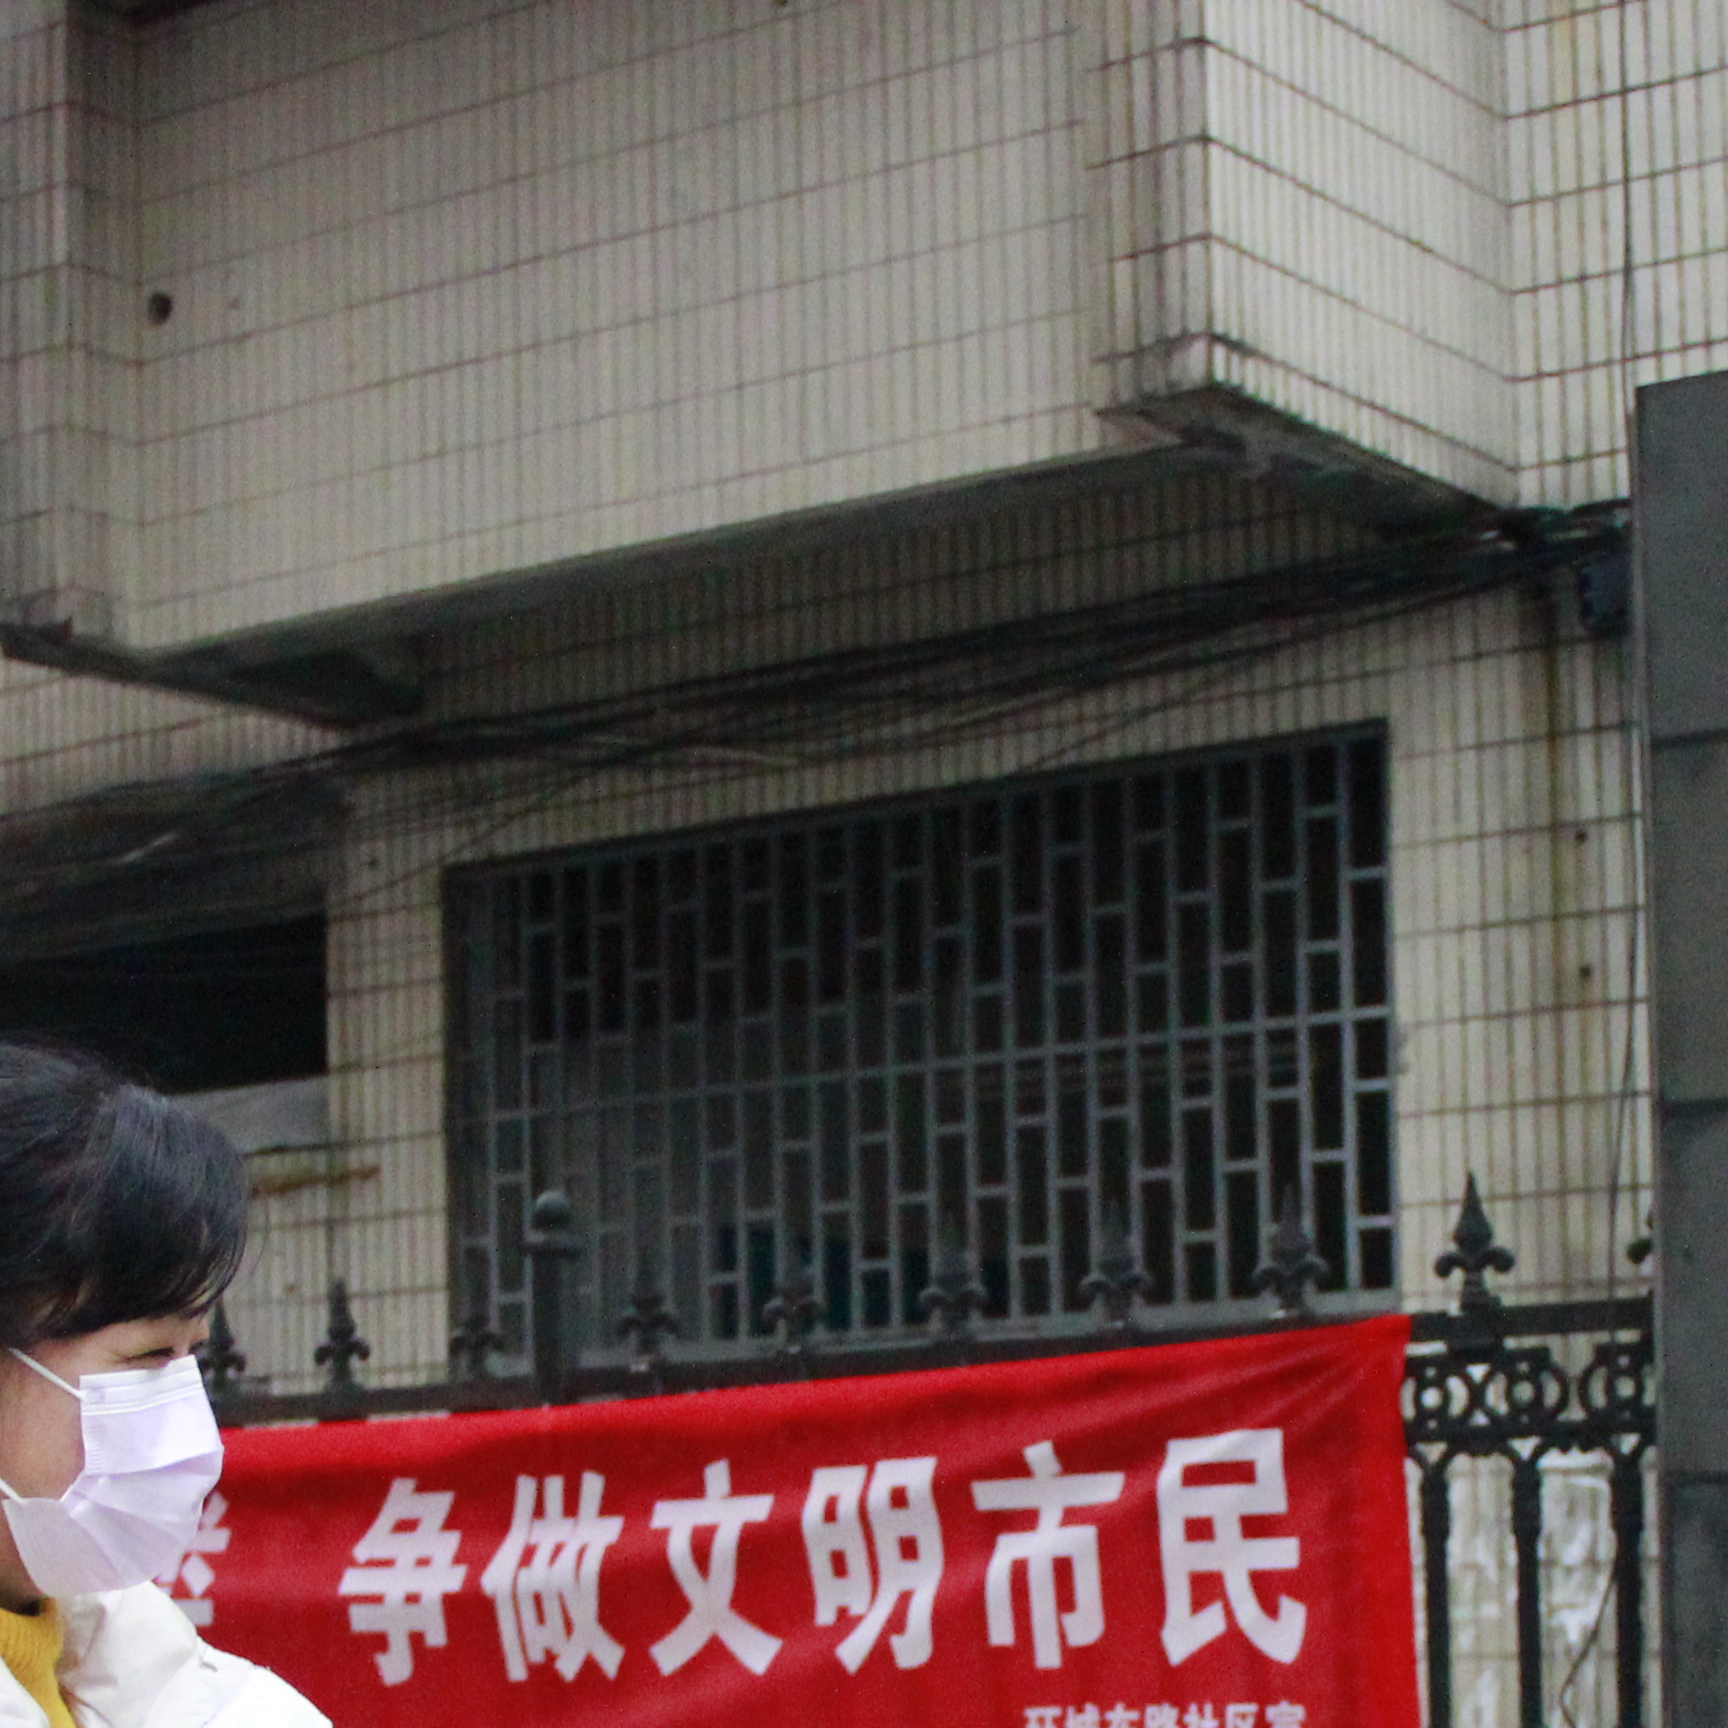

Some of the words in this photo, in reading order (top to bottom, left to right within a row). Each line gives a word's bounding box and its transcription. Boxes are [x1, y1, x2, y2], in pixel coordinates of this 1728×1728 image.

[334, 1425, 1308, 1686] 争做文明市民
